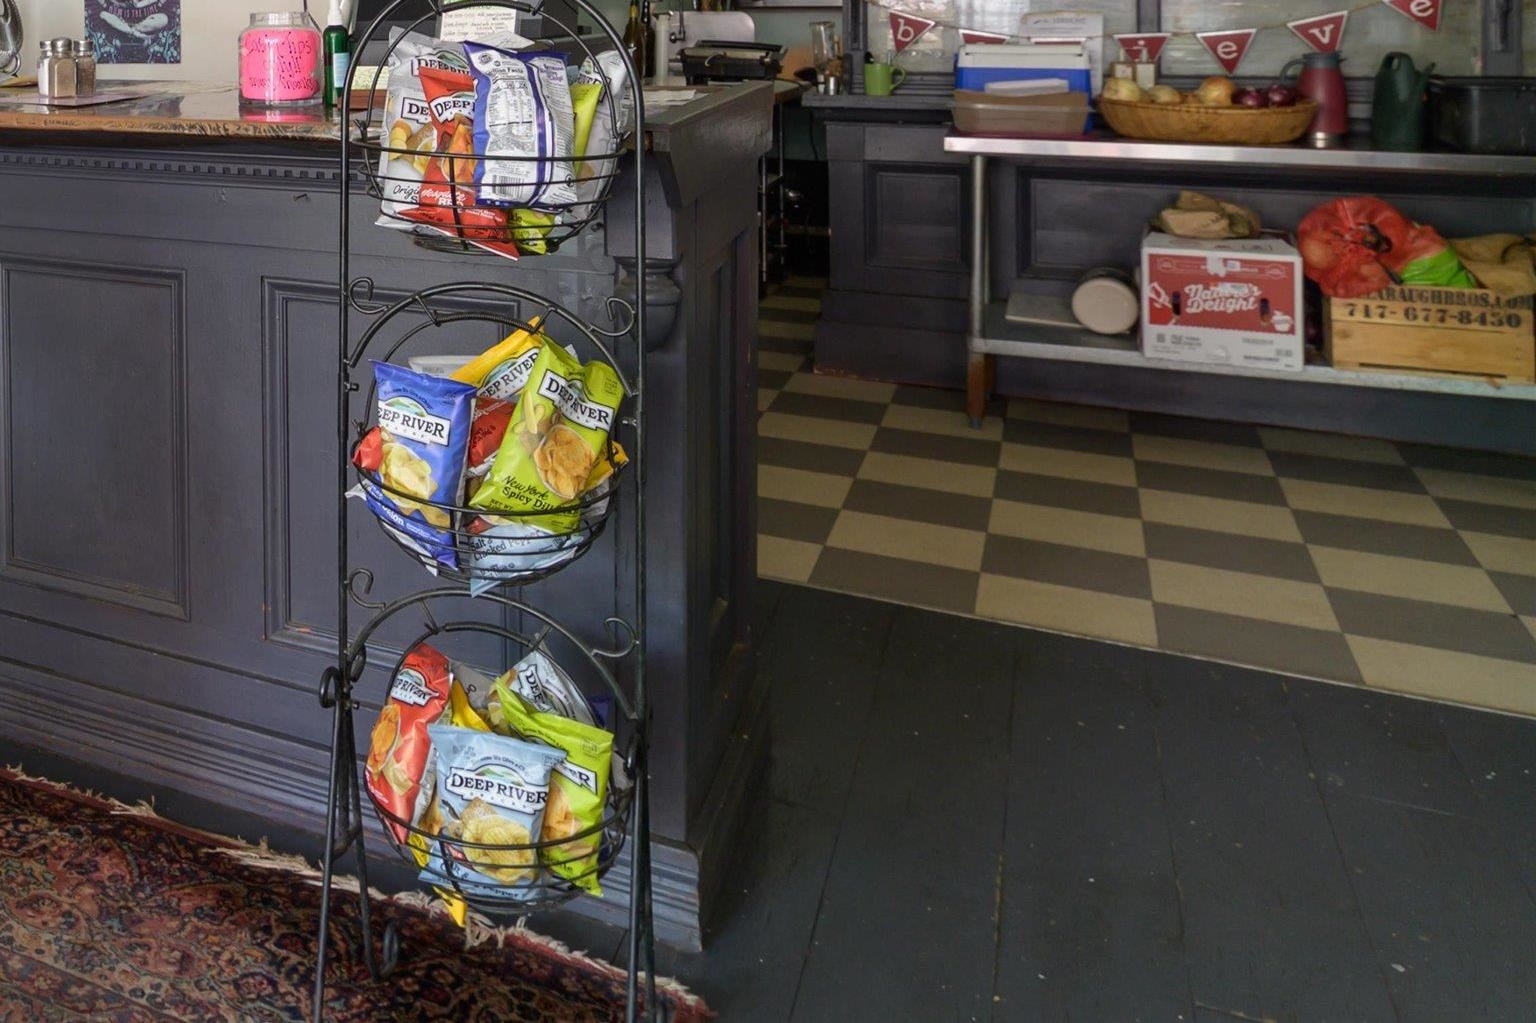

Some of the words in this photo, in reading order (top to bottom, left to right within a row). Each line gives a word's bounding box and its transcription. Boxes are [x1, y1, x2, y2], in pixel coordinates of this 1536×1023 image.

[407, 102, 429, 116] DE
[434, 99, 471, 117] DEEP
[1185, 295, 1259, 313] Delight
[502, 351, 539, 385] RIVER
[377, 408, 400, 425] EEP
[401, 414, 445, 439] RIVER
[502, 475, 525, 491] New
[524, 485, 549, 501] York
[502, 486, 532, 508] Spicy
[451, 773, 495, 792] DEEP
[496, 782, 549, 804] RIVER
